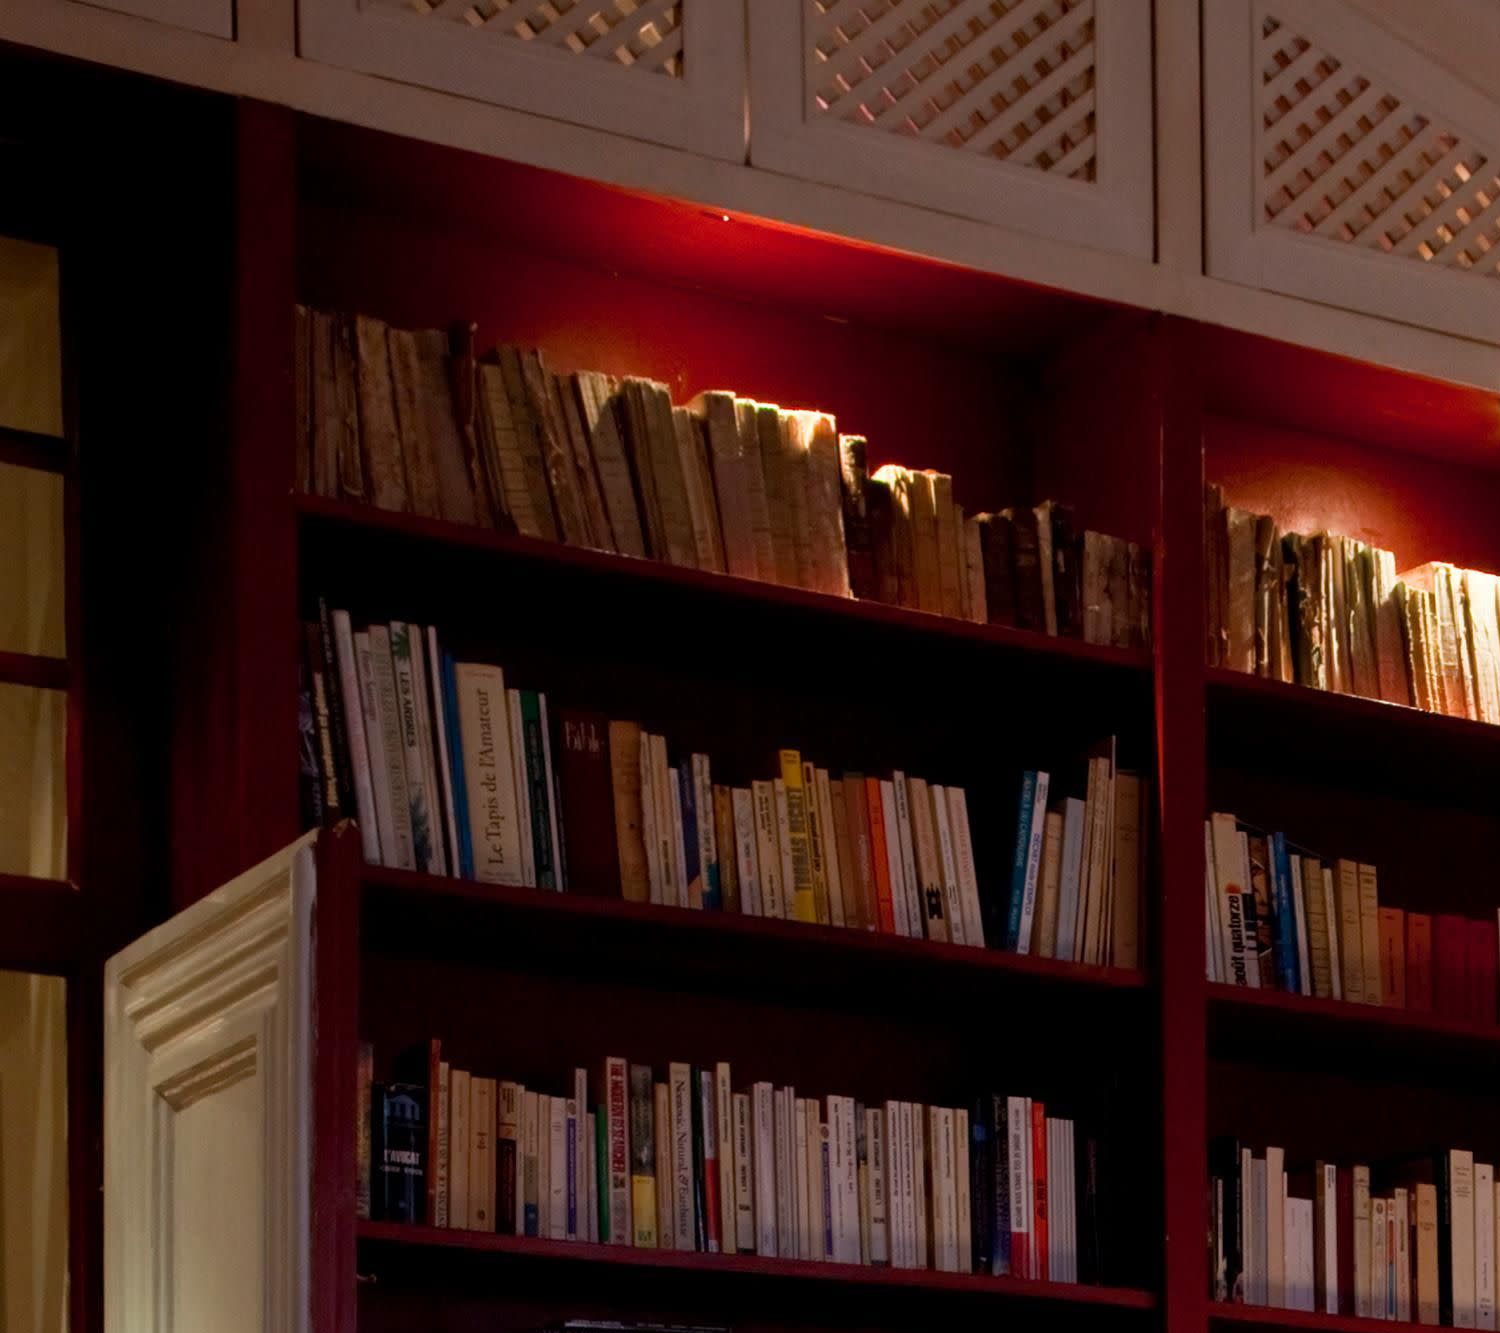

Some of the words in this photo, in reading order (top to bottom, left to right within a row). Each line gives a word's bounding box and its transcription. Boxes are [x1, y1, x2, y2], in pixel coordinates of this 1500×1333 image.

[399, 671, 413, 696] LES
[475, 688, 495, 768] l'Amateur
[480, 774, 497, 792] de
[483, 797, 505, 841] Tapis
[488, 846, 504, 864] Le
[1227, 895, 1244, 953] quatorze
